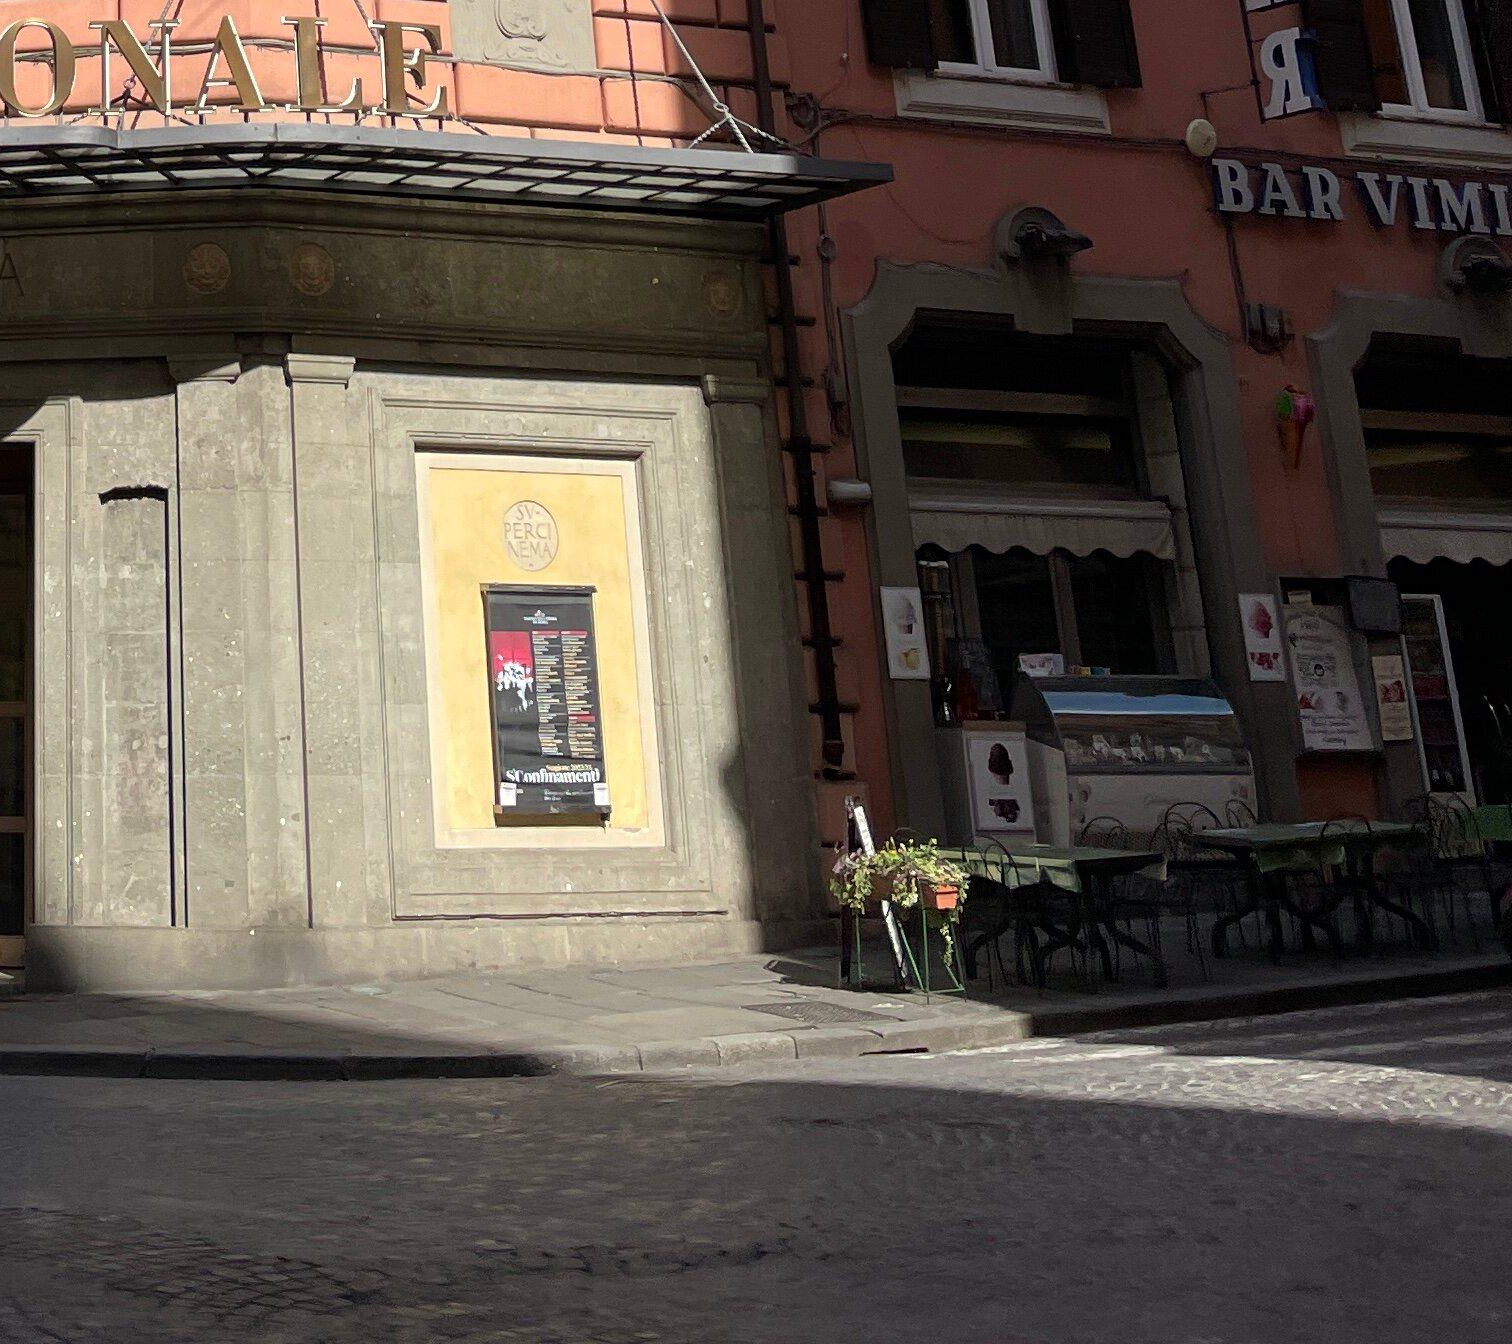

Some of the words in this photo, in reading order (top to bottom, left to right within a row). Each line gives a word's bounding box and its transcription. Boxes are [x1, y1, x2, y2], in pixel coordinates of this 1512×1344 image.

[1212, 158, 1342, 220] BAR
[1356, 172, 1512, 236] VIMI
[503, 522, 552, 541] PERCI
[507, 541, 553, 559] NEMA
